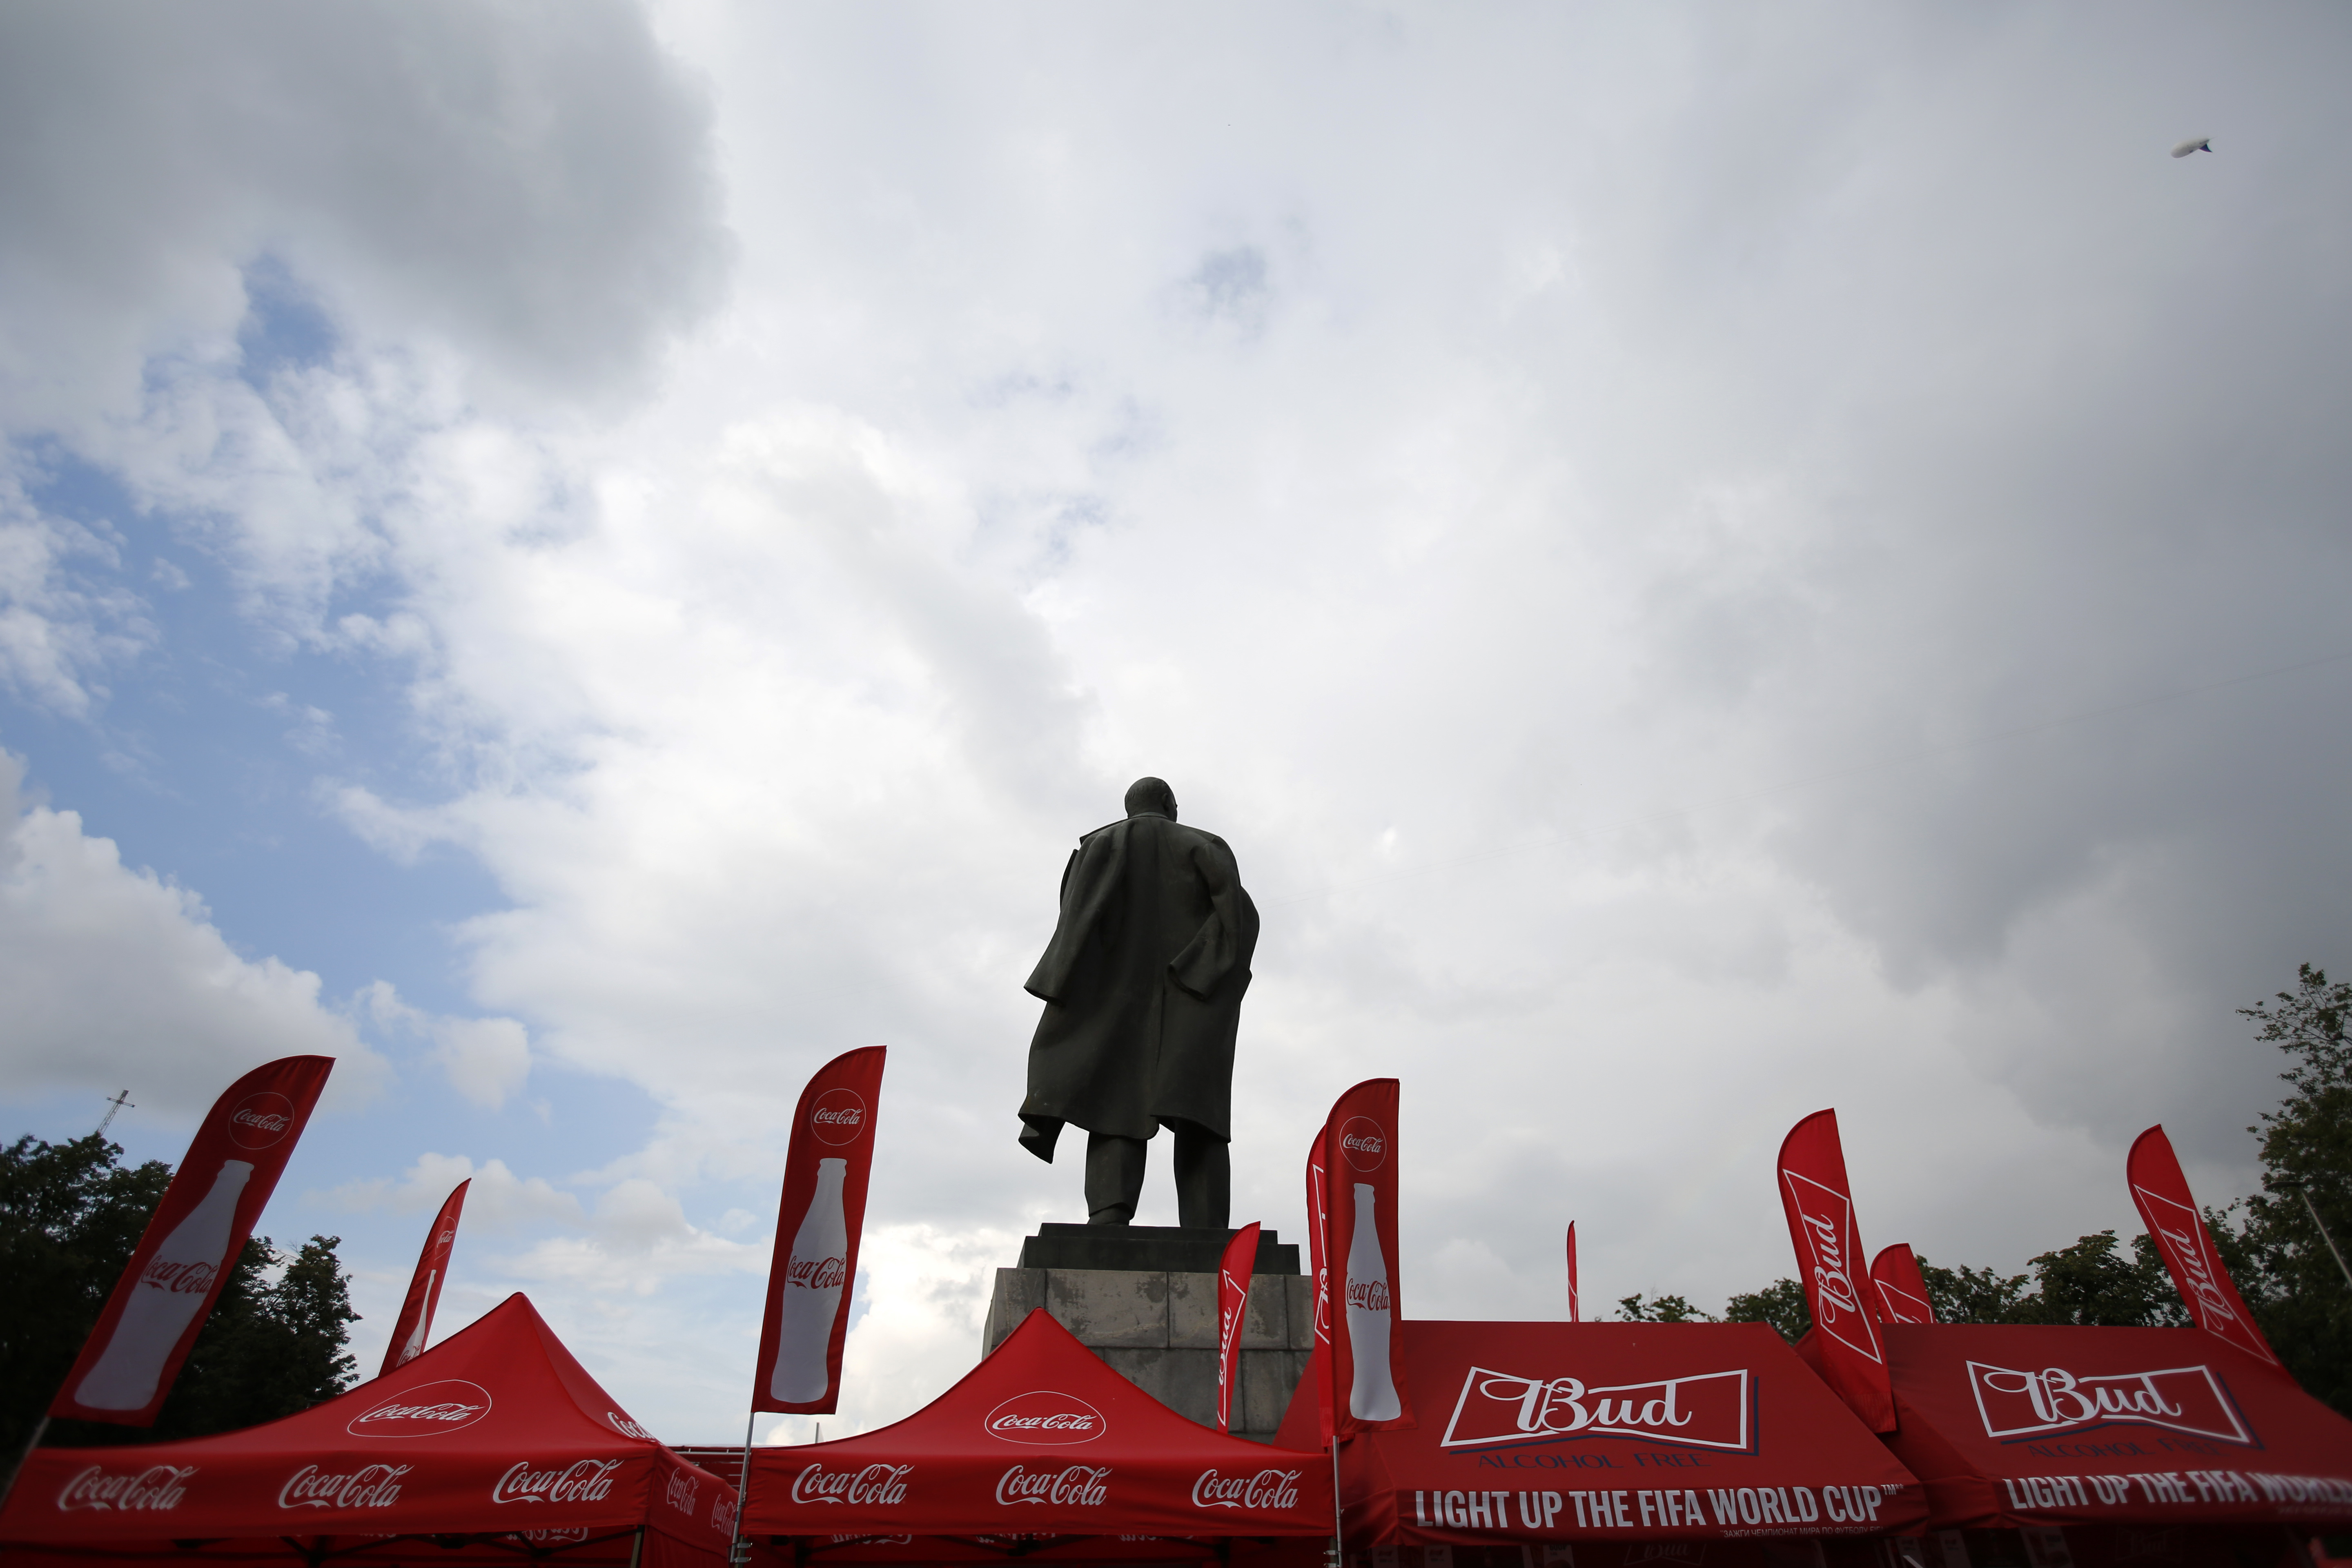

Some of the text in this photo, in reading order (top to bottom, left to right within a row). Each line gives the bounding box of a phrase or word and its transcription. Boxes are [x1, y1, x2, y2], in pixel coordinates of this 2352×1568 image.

[234, 1109, 290, 1131] Coca-Cola
[814, 1107, 863, 1125] Coca-Cola
[1343, 1134, 1383, 1154] Coca-Cola
[141, 1255, 219, 1294] Coca-Cola
[787, 1255, 845, 1289] Coca-Cola
[1803, 1213, 1855, 1324] Bud
[2160, 1228, 2234, 1331] Bud
[1347, 1278, 1390, 1311] Coca-Cola
[359, 1403, 485, 1422] Coca-Cola
[1479, 1377, 1693, 1432] Bud
[1983, 1368, 2181, 1423] Bud
[992, 1414, 1098, 1430] Coca-Cola
[1479, 1454, 1624, 1468] ALCOHOL
[2028, 1442, 2156, 1457] ALCOHOL
[57, 1465, 200, 1510] Coca-Cola
[278, 1465, 414, 1508] Coca-Cola
[493, 1459, 624, 1503] Coca-Cola
[667, 1467, 700, 1516] Coca-Cola
[792, 1463, 914, 1504] Coca-Cola
[996, 1465, 1112, 1506] Coca-Cola
[1192, 1469, 1302, 1508] Coca-Cola
[2002, 1476, 2089, 1509] LIGHT
[2085, 1474, 2130, 1505] UP
[2127, 1472, 2196, 1503] THE
[2185, 1471, 2258, 1502] FIFA
[1416, 1490, 1510, 1528] LIGHT
[1519, 1491, 1562, 1528] UP
[1568, 1490, 1634, 1528] THE
[1637, 1490, 1707, 1527] FIFA
[1706, 1487, 1819, 1525] WORLD
[1751, 1528, 1797, 1537] ЧЕМПИОНАТ
